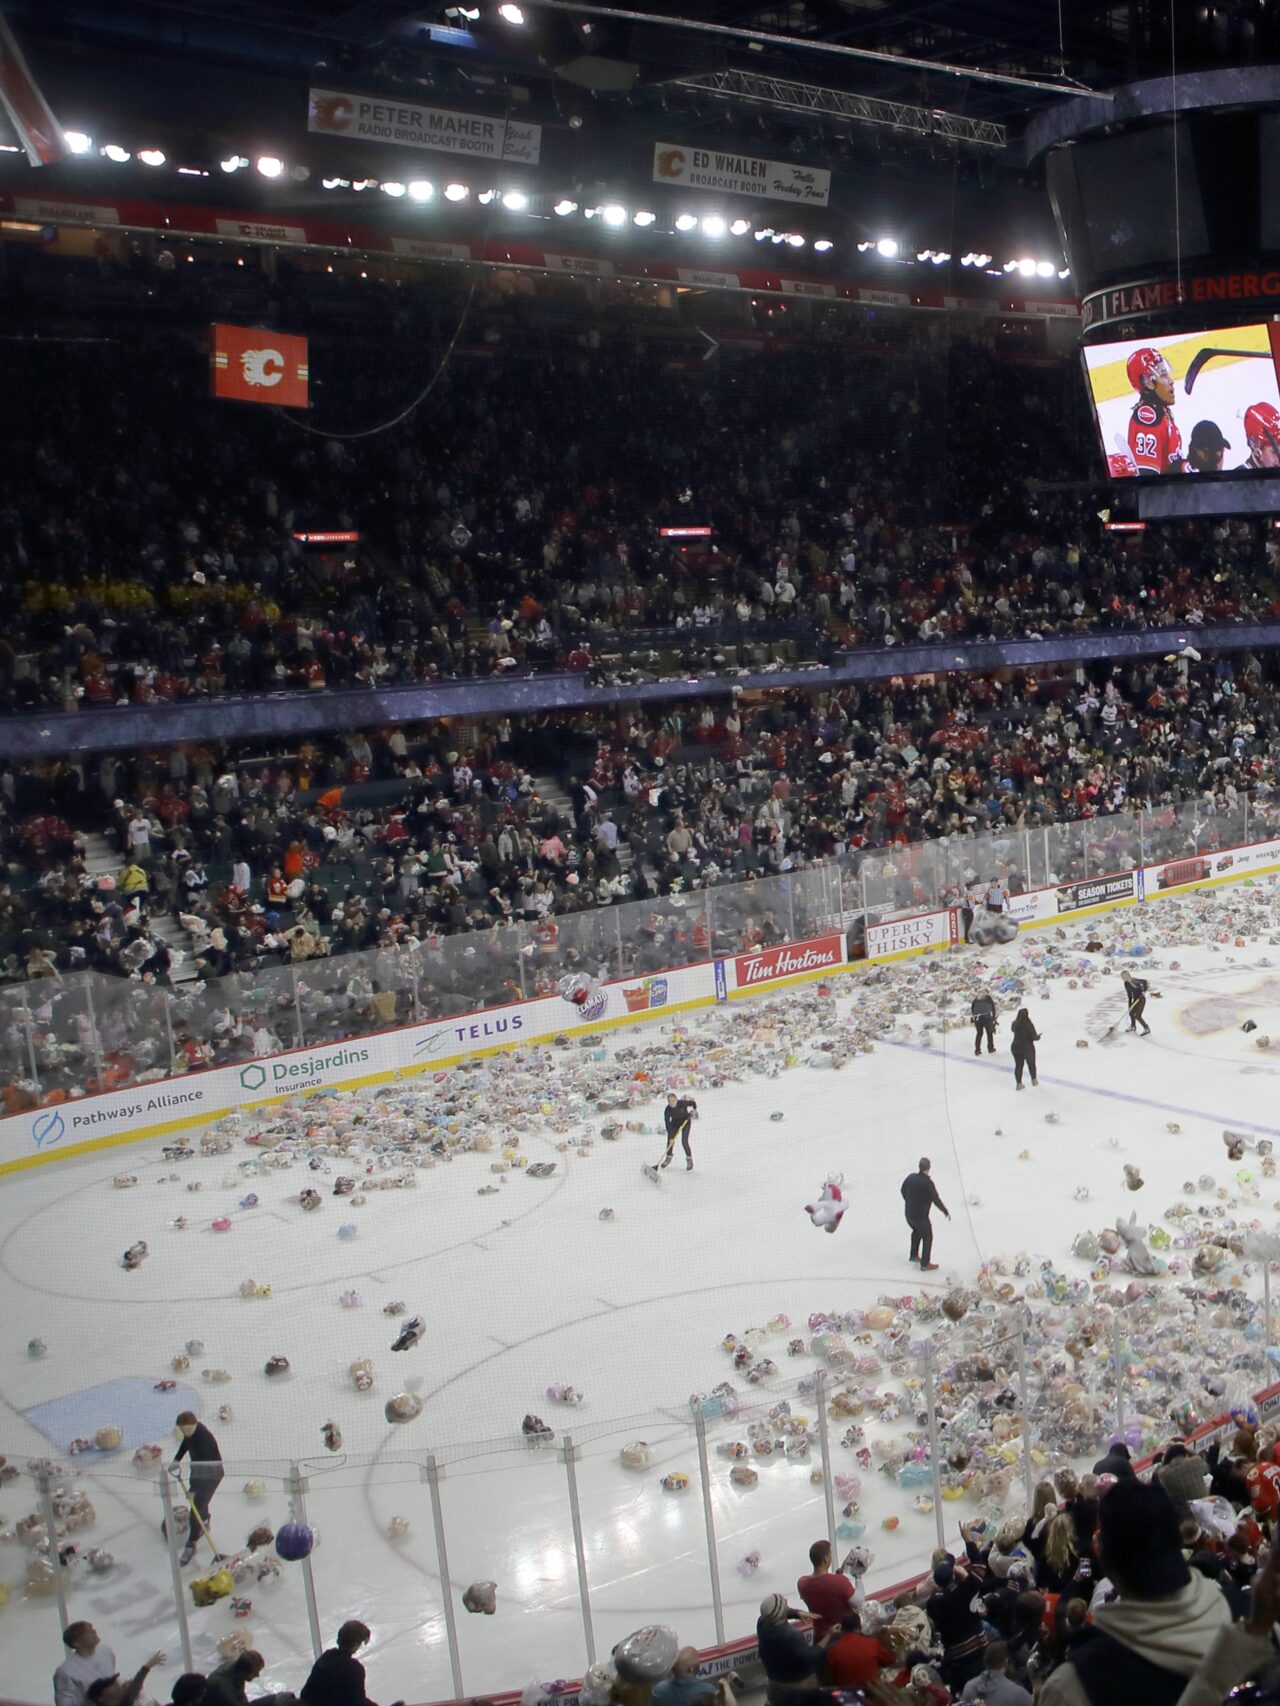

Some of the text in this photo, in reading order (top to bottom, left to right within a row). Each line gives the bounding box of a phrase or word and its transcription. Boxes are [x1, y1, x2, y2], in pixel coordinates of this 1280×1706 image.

[358, 102, 495, 138] PETER MAHER
[357, 122, 495, 154] RADIO BROADCAST BOOTH
[692, 151, 768, 179] ED WHALEN
[689, 173, 767, 195] BROADCAST BOOTH
[1111, 280, 1187, 315] FLAMES
[1135, 433, 1157, 457] 32
[1077, 885, 1106, 901] SEASON
[1106, 878, 1134, 895] TICKETS
[867, 918, 935, 943] UPERT'S
[743, 956, 773, 982] Tim
[775, 948, 835, 975] Hortons
[454, 1015, 523, 1042] TELUS
[272, 1048, 370, 1081] Desjardins
[274, 1078, 323, 1094] Insurance
[72, 1090, 204, 1129] Pathways Alliance
[714, 1660, 731, 1672] THE
[733, 1652, 760, 1669] POWE
